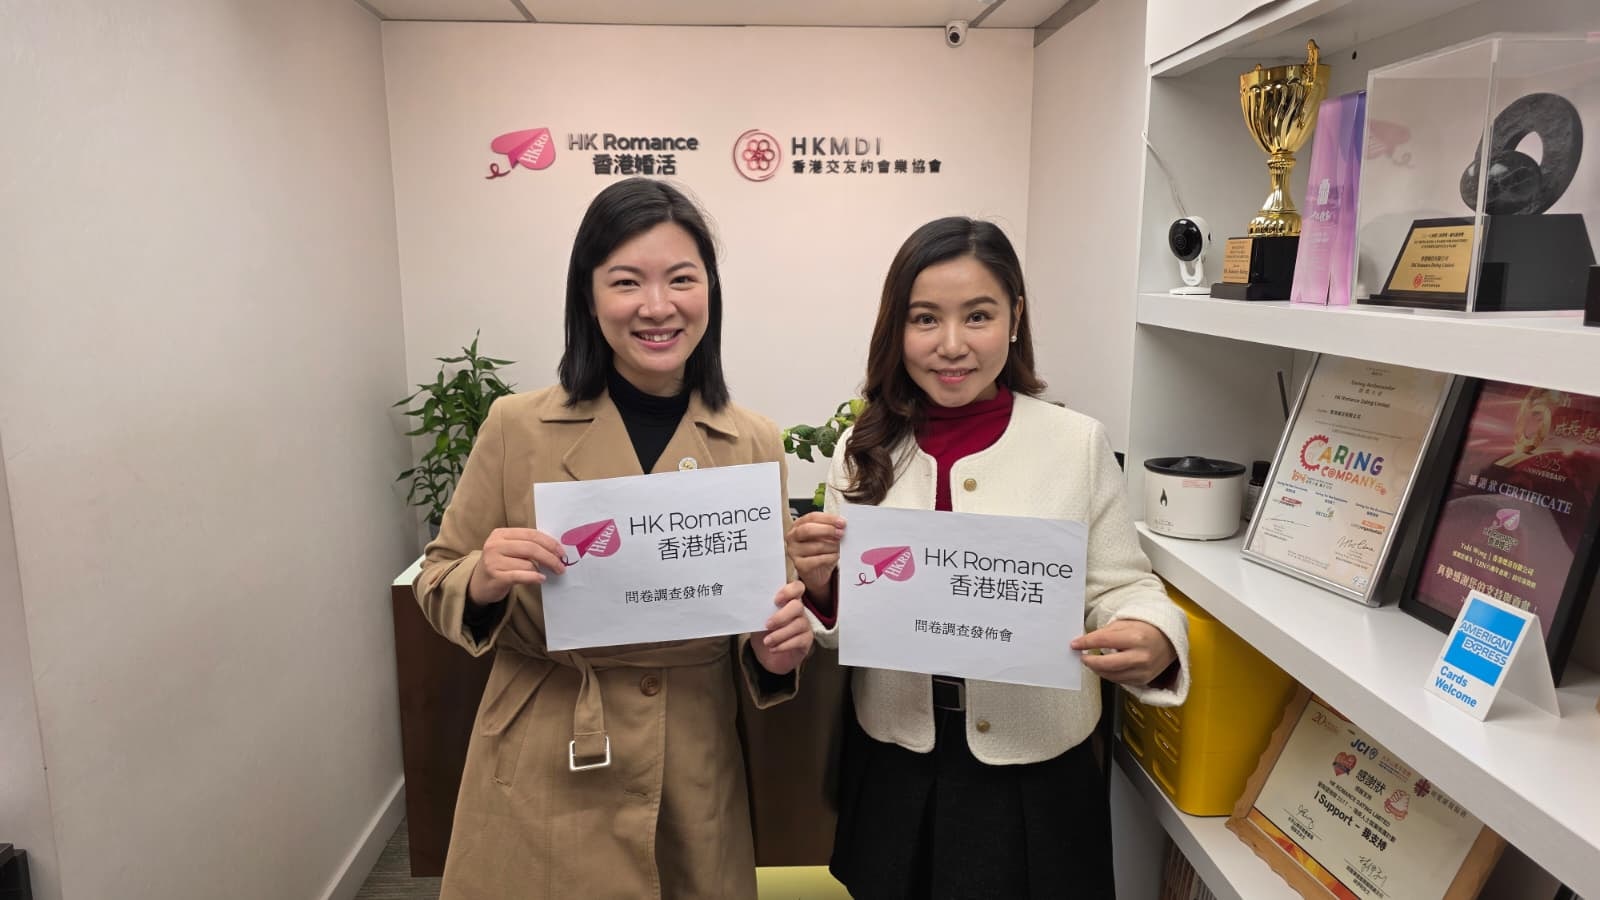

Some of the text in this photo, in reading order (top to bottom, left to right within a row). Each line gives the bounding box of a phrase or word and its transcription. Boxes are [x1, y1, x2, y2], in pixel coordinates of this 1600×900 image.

[568, 133, 699, 151] HK Romance
[791, 136, 882, 156] HKMDI
[592, 154, 677, 176] 香港婚活
[1300, 434, 1385, 476] CARING
[1321, 466, 1377, 488] COMPANY
[1498, 482, 1572, 514] CERTIFICATE
[629, 506, 771, 536] HK Romance
[658, 529, 748, 561] 香港婚活
[924, 547, 1073, 579] HK Romance
[625, 582, 723, 604] 問卷調查發佈會
[950, 574, 1044, 604] 香港婚活
[914, 619, 1014, 643] 問卷調查發佈會
[1460, 621, 1511, 651] AMERICAN
[1463, 638, 1507, 666] EXPRESS
[1440, 665, 1468, 688] Cards
[1434, 676, 1478, 708] Welcome
[1350, 739, 1369, 755] JCI
[1355, 768, 1386, 796] 感謝狀
[1313, 790, 1320, 800] I
[1318, 794, 1353, 826] Support
[1361, 827, 1387, 852] 我支持
